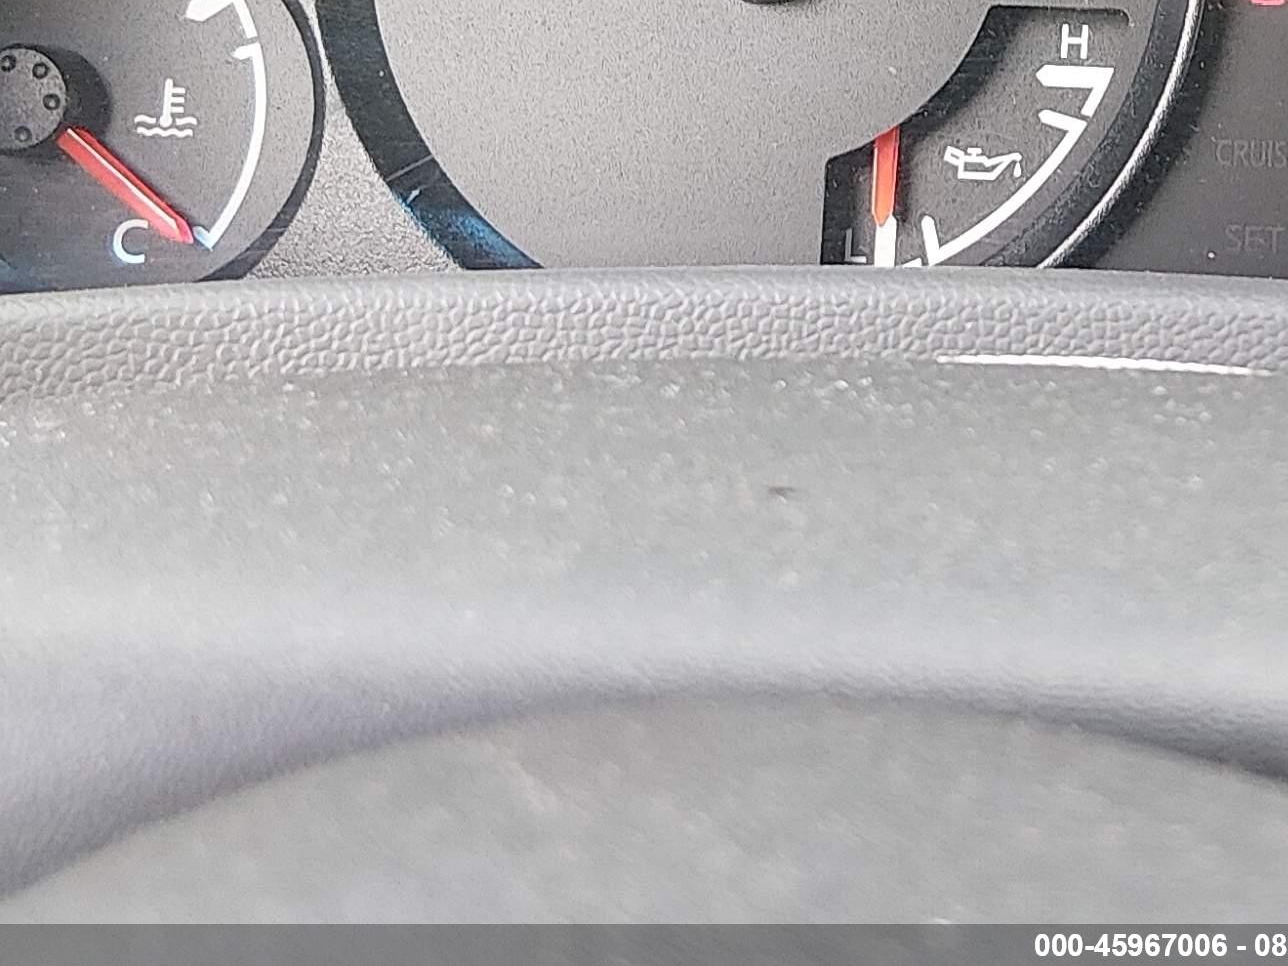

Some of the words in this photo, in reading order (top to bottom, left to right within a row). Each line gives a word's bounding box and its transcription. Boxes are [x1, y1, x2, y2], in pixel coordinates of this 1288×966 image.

[1060, 23, 1090, 59] H
[112, 221, 148, 264] C
[1224, 224, 1286, 254] SET
